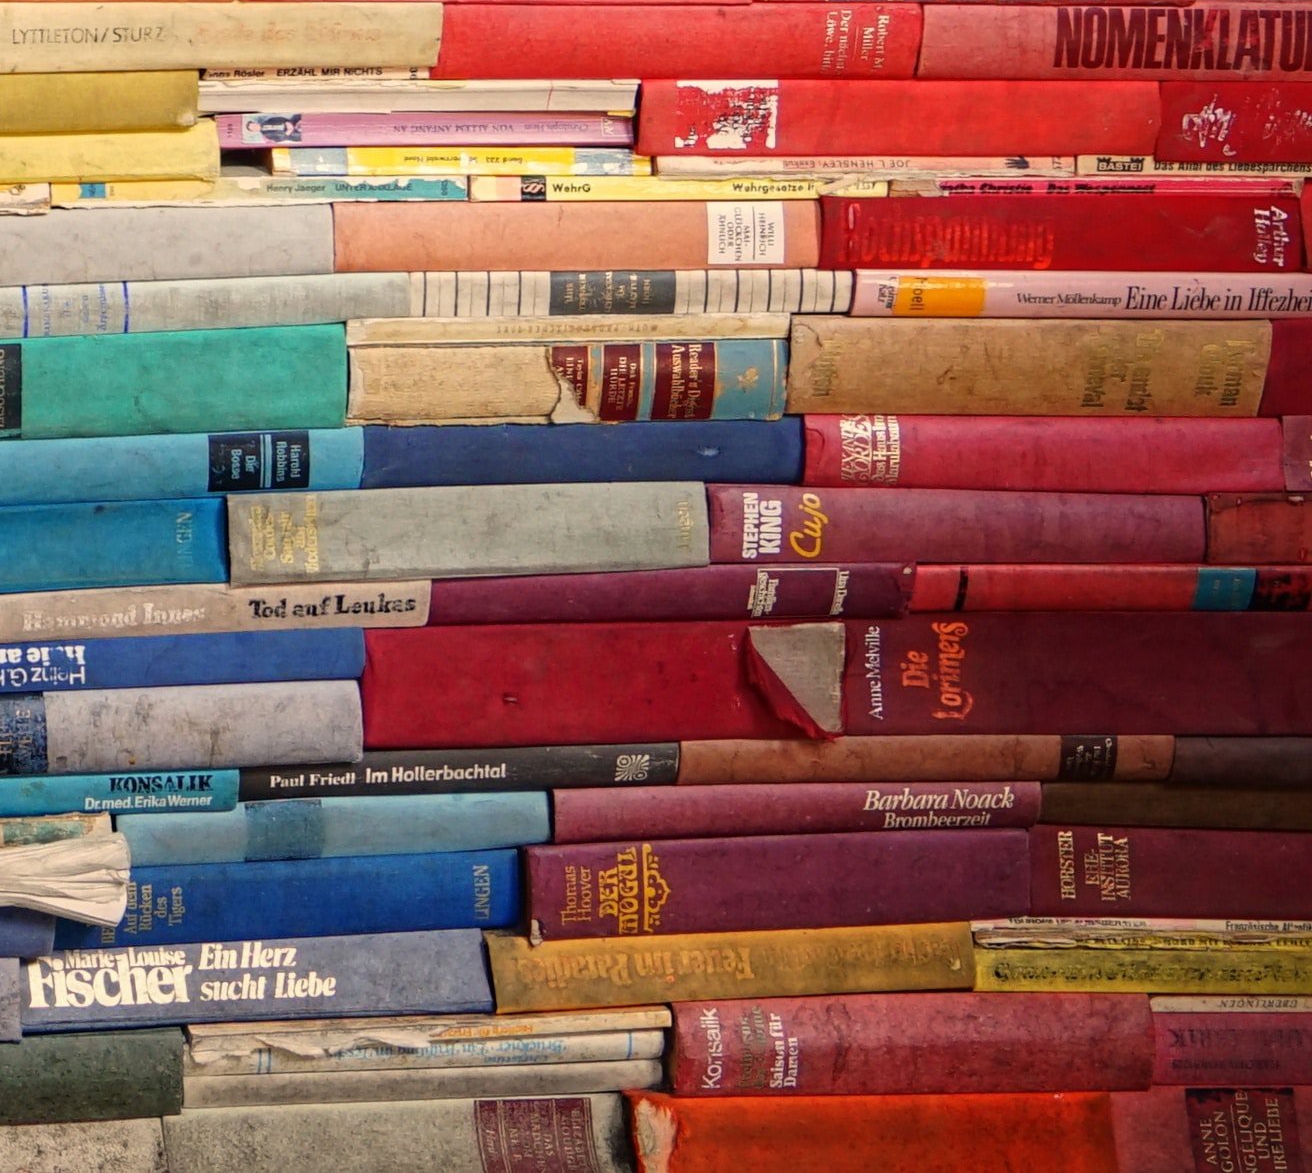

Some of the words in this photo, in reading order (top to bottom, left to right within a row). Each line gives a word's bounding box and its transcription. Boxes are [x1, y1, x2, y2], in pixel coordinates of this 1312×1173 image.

[742, 492, 759, 559] STEPHEN
[759, 500, 782, 554] KING
[790, 493, 829, 558] Cujo
[249, 599, 287, 619] Tod
[292, 596, 332, 618] auf
[335, 593, 415, 616] Leukas
[109, 775, 213, 794] KONSALIK
[271, 773, 304, 788] Paul
[310, 771, 355, 787] Friedl
[365, 768, 387, 784] Im
[391, 762, 506, 783] Hollerbachtal
[167, 795, 212, 807] Werner
[863, 787, 948, 811] Barbara
[950, 786, 1014, 809] Noack
[883, 812, 991, 827] Brombeerzeit
[65, 947, 185, 969] Marie-Louise
[198, 944, 238, 969] Ein
[238, 943, 297, 969] Herz
[27, 957, 194, 1009] Fischer
[200, 974, 266, 1001] sucht
[274, 972, 335, 997] Liebe
